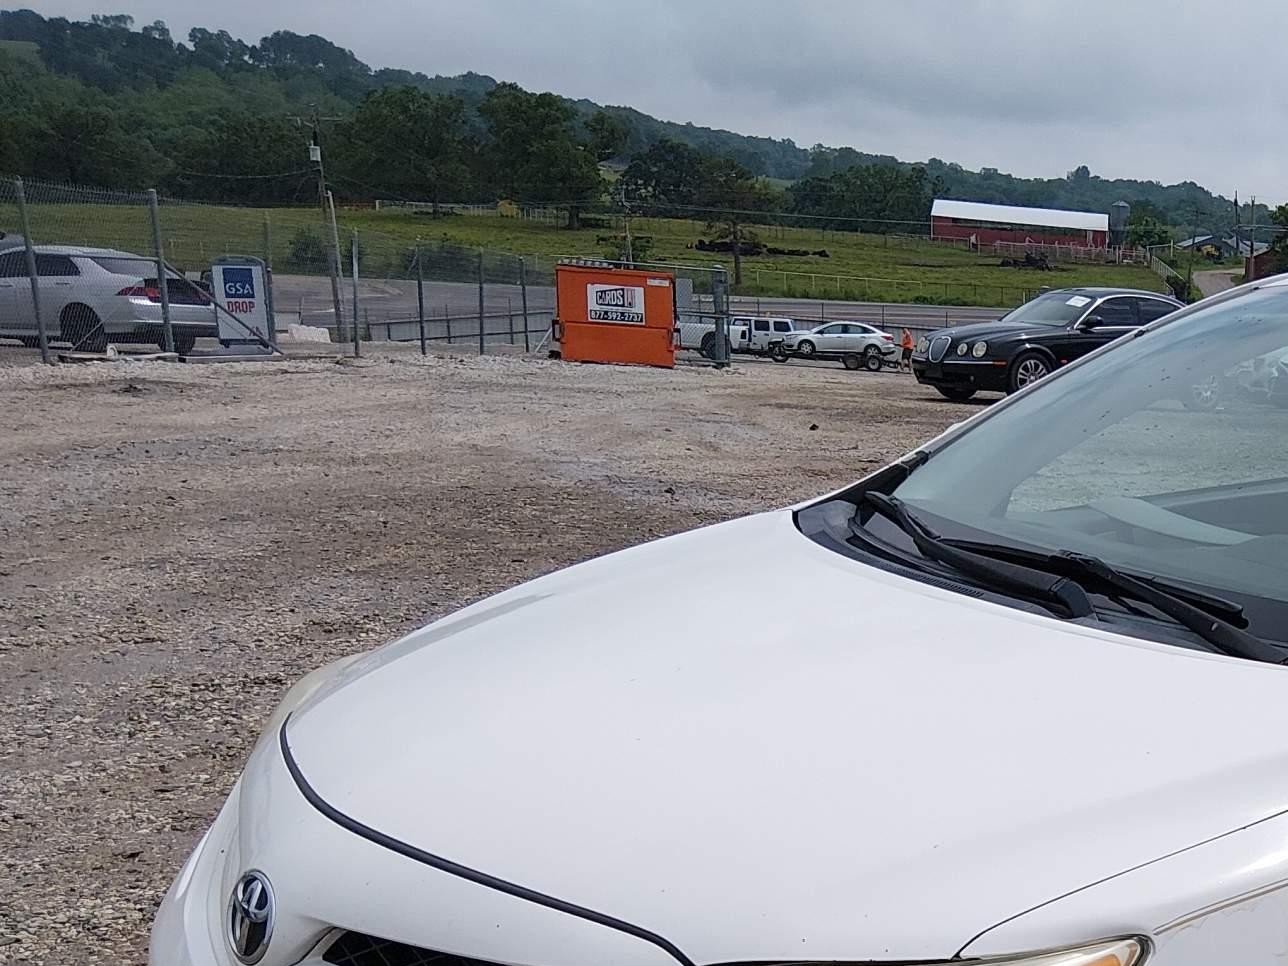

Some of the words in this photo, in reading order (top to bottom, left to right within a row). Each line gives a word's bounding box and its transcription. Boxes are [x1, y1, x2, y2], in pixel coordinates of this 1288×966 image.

[226, 282, 253, 294] GSA
[596, 289, 624, 305] CARDS
[227, 300, 256, 314] DROP
[591, 310, 642, 322] 877-592-2737
